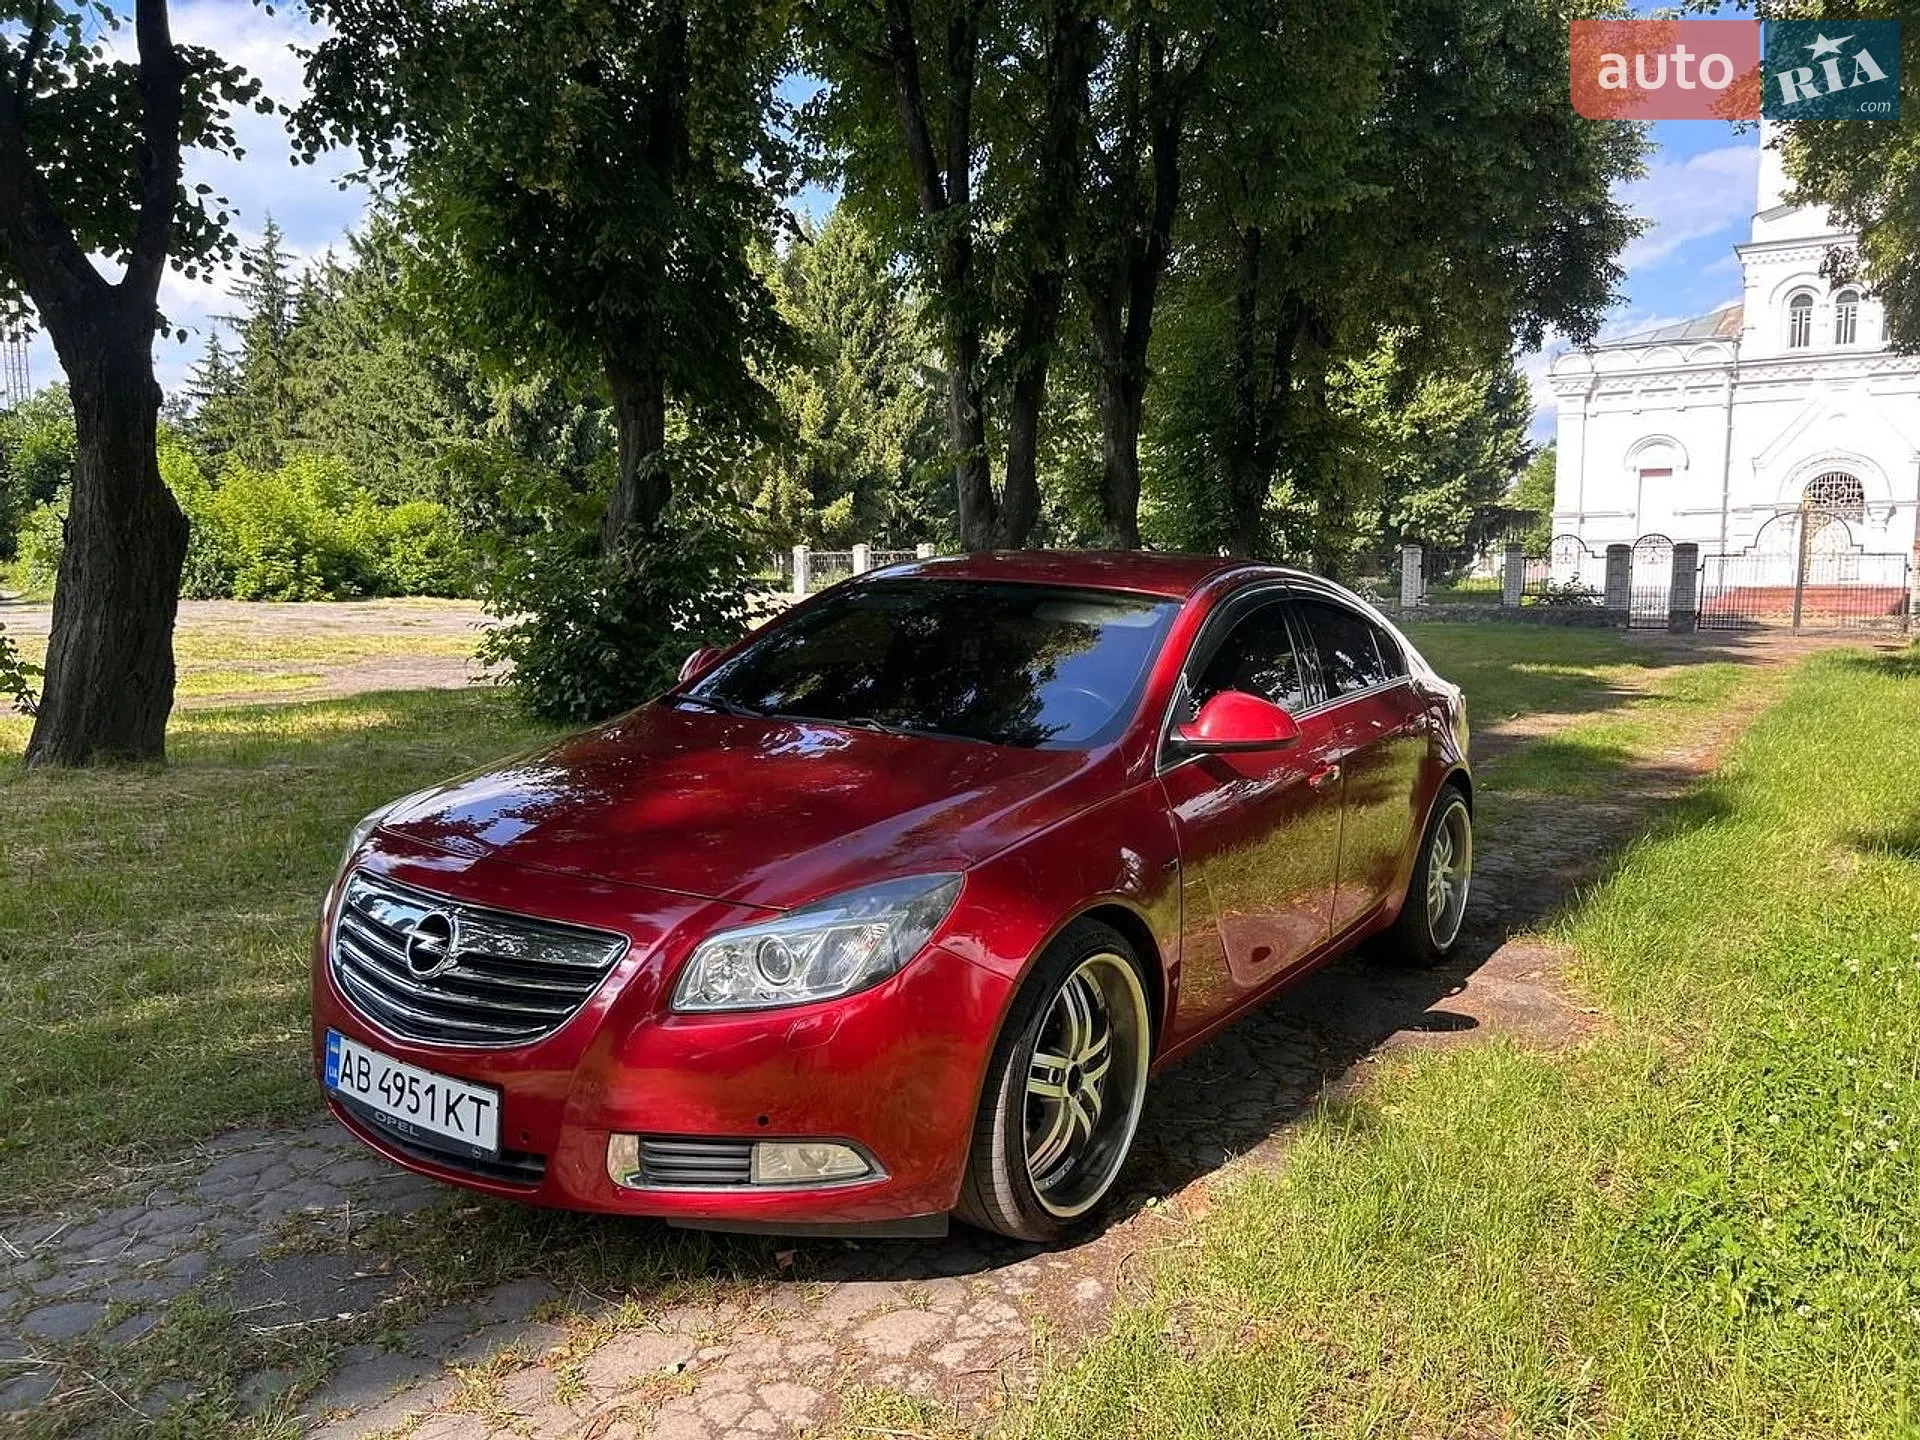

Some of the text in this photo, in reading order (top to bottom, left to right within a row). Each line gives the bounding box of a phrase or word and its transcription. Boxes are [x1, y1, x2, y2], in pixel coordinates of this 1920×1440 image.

[341, 1049, 490, 1137] AB 4951 KT
[374, 1111, 419, 1137] OPEL
